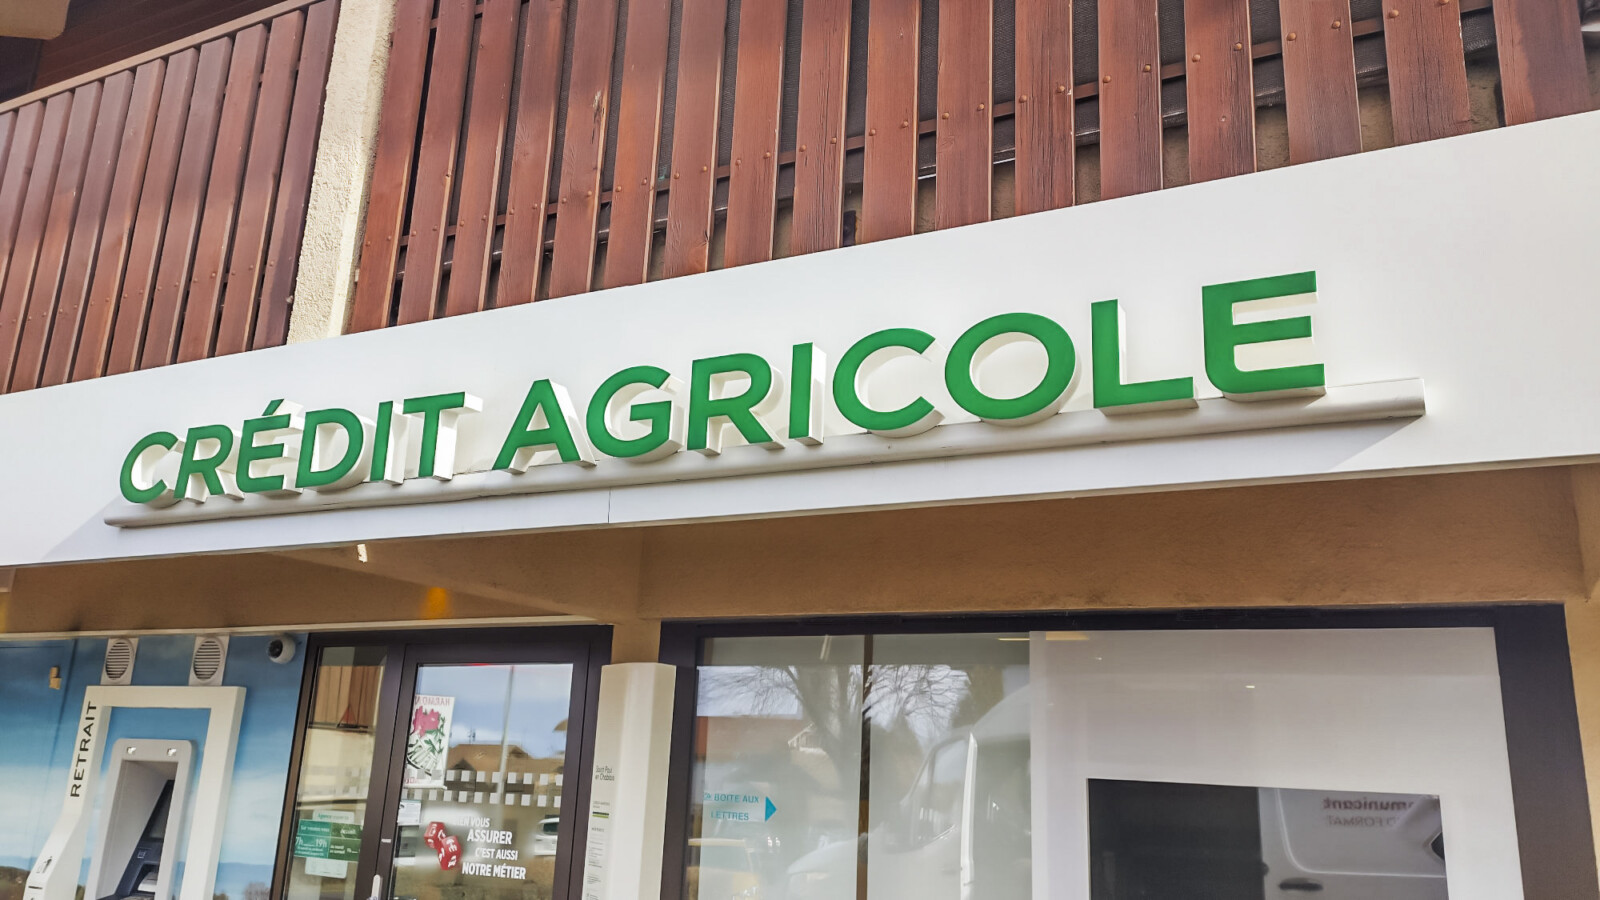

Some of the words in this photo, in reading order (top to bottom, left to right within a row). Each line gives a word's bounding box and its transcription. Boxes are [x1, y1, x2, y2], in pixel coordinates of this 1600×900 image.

[119, 391, 467, 504] CRÉDIT
[493, 270, 1326, 471] AGRICOLE
[70, 701, 97, 797] RETRAIT
[742, 794, 759, 804] AUX
[471, 816, 491, 828] VOUS
[711, 810, 749, 821] LETTRES
[467, 828, 513, 845] ASSURER
[475, 847, 495, 859] C'EST
[496, 849, 518, 861] AUSSI
[462, 862, 492, 877] NOTRE
[493, 862, 526, 880] MÉTIER
